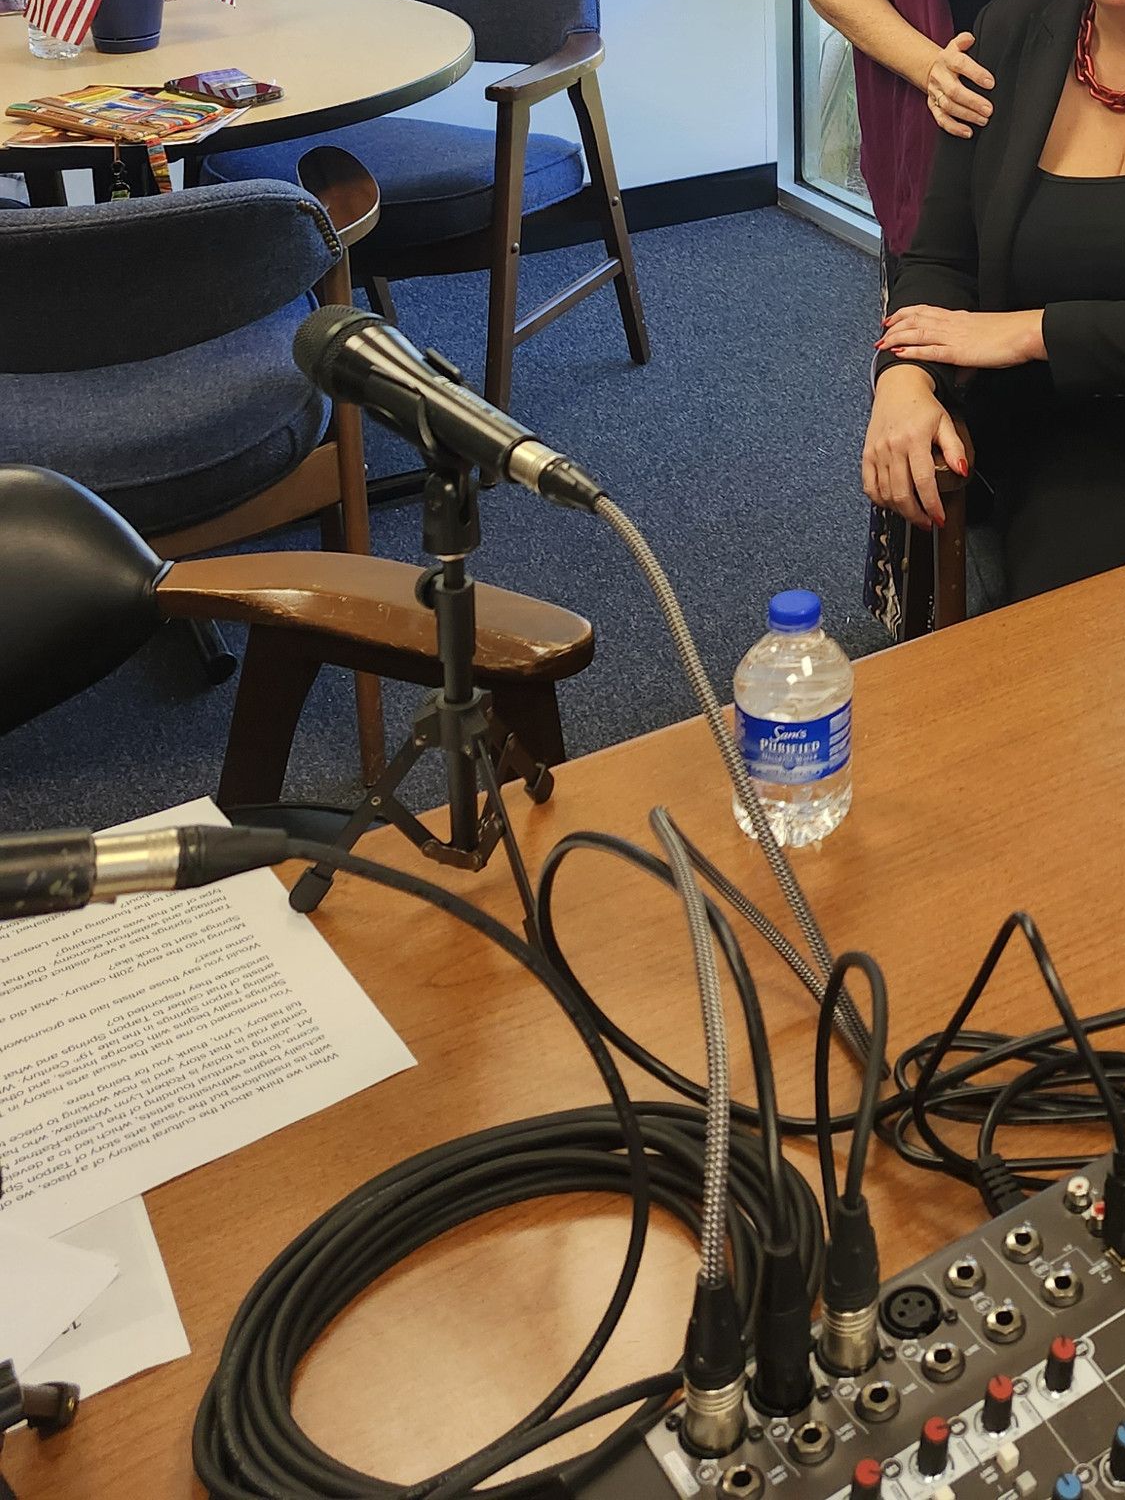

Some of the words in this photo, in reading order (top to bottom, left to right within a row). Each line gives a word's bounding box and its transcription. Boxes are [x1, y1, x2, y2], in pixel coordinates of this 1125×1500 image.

[770, 725, 807, 741] Sam's
[759, 738, 820, 754] PURIFIED
[225, 942, 261, 960] Would
[203, 956, 224, 968] you
[214, 954, 269, 980] landscape
[182, 967, 201, 977] say
[242, 962, 274, 978] artists
[149, 975, 180, 990] those
[189, 979, 212, 991] they
[229, 978, 240, 986] of
[242, 971, 280, 989] visiting
[206, 983, 227, 995] that
[244, 978, 286, 998] Springs
[269, 988, 292, 999] You
[112, 988, 145, 1004] artists
[126, 989, 186, 1017] responded
[167, 993, 203, 1011] caliber
[201, 988, 240, 1006] Tarpon
[89, 1003, 110, 1015] laid
[210, 997, 267, 1026] mentioned
[213, 997, 242, 1013] really
[285, 1000, 302, 1011] full
[68, 1012, 87, 1023] the
[106, 1015, 124, 1027] to?
[156, 1005, 199, 1025] Springs
[172, 1011, 211, 1029] begins
[270, 1008, 307, 1029] central
[108, 1015, 150, 1034] Tarpon
[196, 1023, 208, 1031] to
[247, 1026, 268, 1038] role
[122, 1030, 141, 1040] the
[146, 1028, 170, 1040] with
[175, 1029, 193, 1039] me
[233, 1036, 245, 1044] in
[251, 1026, 290, 1048] Joining
[61, 1033, 106, 1054] Springs
[98, 1038, 120, 1050] late
[100, 1039, 144, 1060] George
[150, 1038, 173, 1051] that
[176, 1041, 208, 1057] thank
[209, 1042, 231, 1055] that
[235, 1046, 249, 1054] us
[269, 1043, 281, 1051] to
[284, 1034, 325, 1056] actually
[308, 1043, 332, 1056] with
[35, 1053, 58, 1067] and
[129, 1048, 148, 1059] the
[249, 1050, 267, 1060] the
[293, 1054, 307, 1063] its
[305, 1052, 339, 1070] When
[92, 1058, 127, 1076] visual
[152, 1055, 174, 1068] you
[179, 1054, 206, 1069] story
[201, 1053, 233, 1070] today
[243, 1055, 282, 1074] begins
[3, 1064, 33, 1080] what
[134, 1067, 150, 1077] for
[153, 1066, 175, 1080] and
[197, 1059, 246, 1084] eventual
[230, 1062, 291, 1091] institutions
[286, 1068, 303, 1078] we
[27, 1078, 50, 1093] and
[66, 1073, 88, 1086] arts
[96, 1074, 131, 1092] being
[146, 1074, 186, 1095] Robert
[255, 1077, 284, 1092] think
[23, 1084, 64, 1105] history
[113, 1083, 137, 1097] now
[143, 1081, 195, 1107] founding
[209, 1090, 229, 1102] but
[61, 1095, 110, 1119] working
[113, 1092, 144, 1108] Lynn
[188, 1100, 207, 1111] the
[219, 1090, 253, 1109] about
[7, 1104, 19, 1112] in
[129, 1105, 141, 1115] of
[199, 1107, 218, 1118] the
[46, 1117, 59, 1125] to
[106, 1112, 126, 1123] the
[150, 1110, 185, 1129] visual
[9, 1122, 43, 1142] piece
[96, 1121, 132, 1139] which
[124, 1126, 146, 1139] arts
[152, 1116, 196, 1140] cultural
[22, 1134, 48, 1148] who
[74, 1138, 94, 1151] led
[90, 1139, 121, 1155] story
[108, 1137, 150, 1159] history
[58, 1148, 71, 1156] to
[75, 1153, 87, 1163] of
[92, 1157, 104, 1168] of
[27, 1161, 71, 1183] Tarpon
[38, 1168, 77, 1189] place,
[15, 1190, 35, 1201] we
